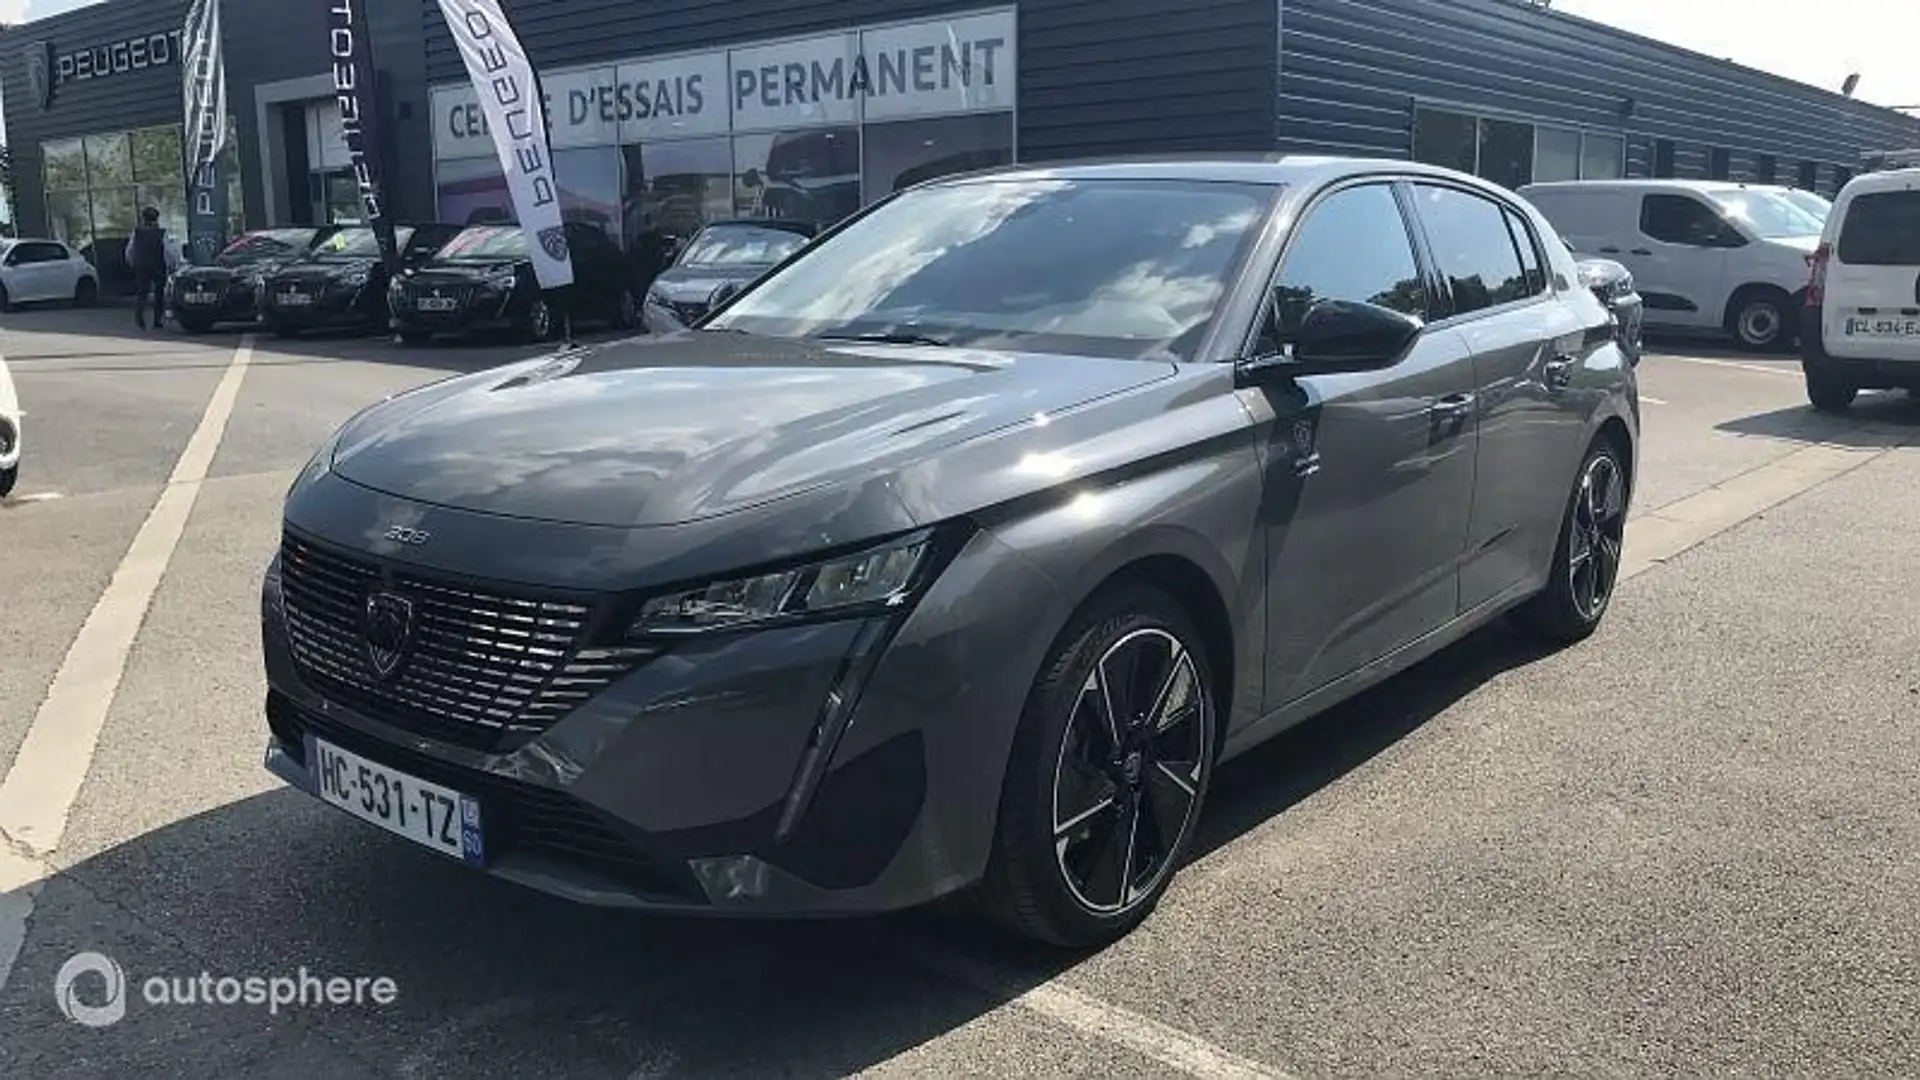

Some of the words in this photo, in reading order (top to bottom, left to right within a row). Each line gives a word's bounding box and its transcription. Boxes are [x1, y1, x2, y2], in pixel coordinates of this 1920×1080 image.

[568, 73, 705, 127] D'ESSAIS
[735, 37, 1005, 111] PERMANENT
[321, 748, 458, 847] HC-531-TZ
